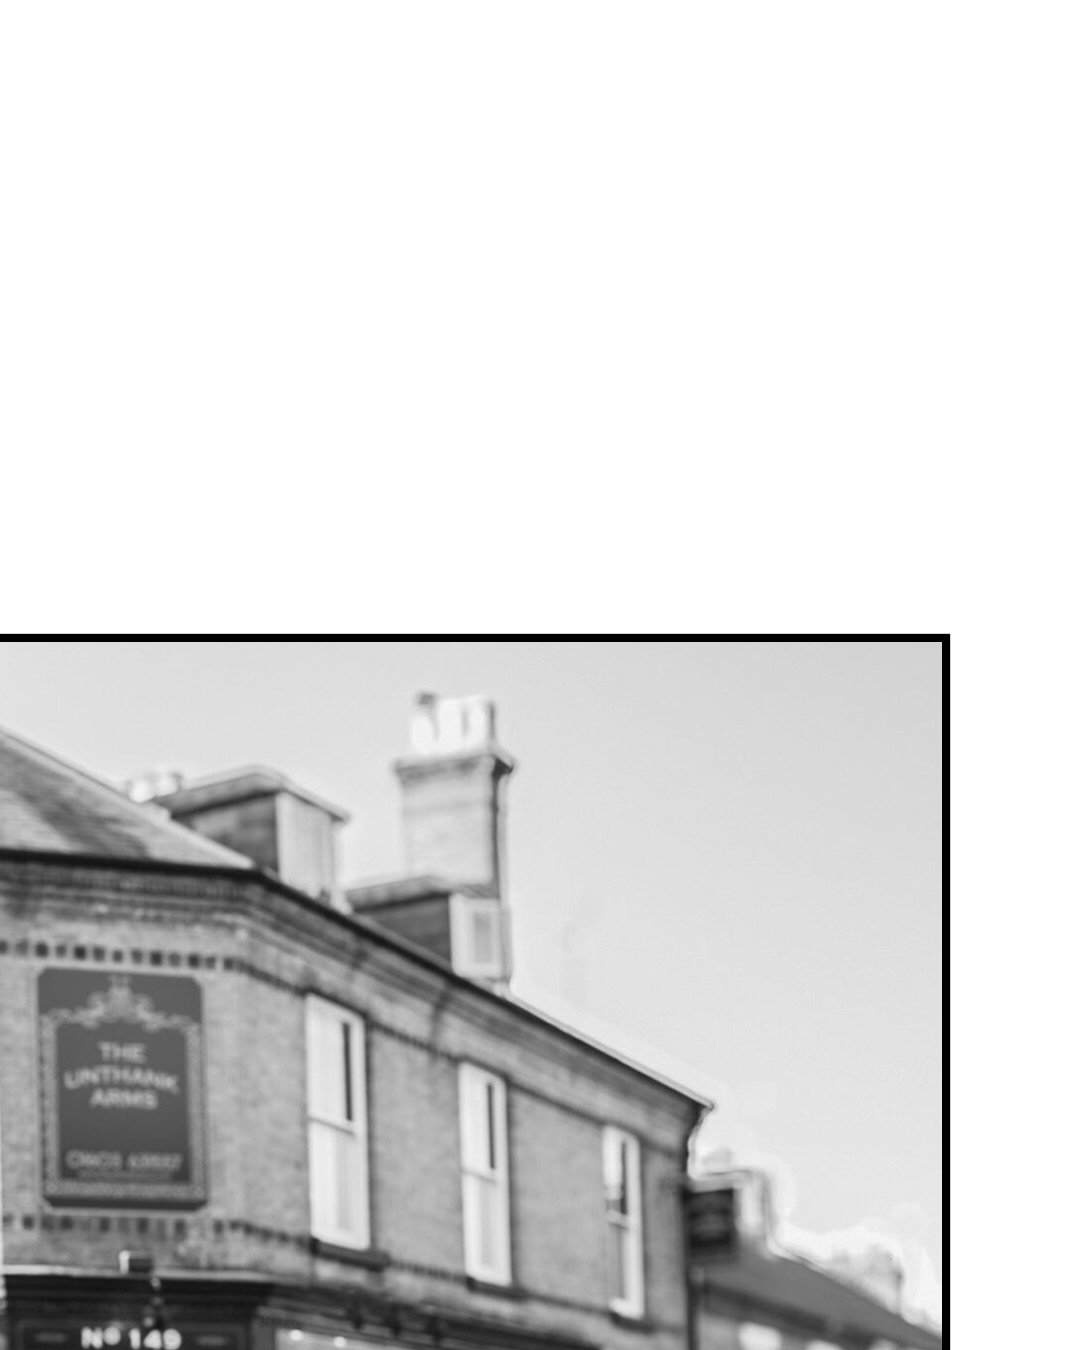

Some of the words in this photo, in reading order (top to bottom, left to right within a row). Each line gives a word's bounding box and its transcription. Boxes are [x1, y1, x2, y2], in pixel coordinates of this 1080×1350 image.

[98, 1041, 147, 1064] THE
[64, 1065, 179, 1096] UNTHANK
[90, 1087, 159, 1110] ARMS
[129, 1327, 182, 1350] 149
